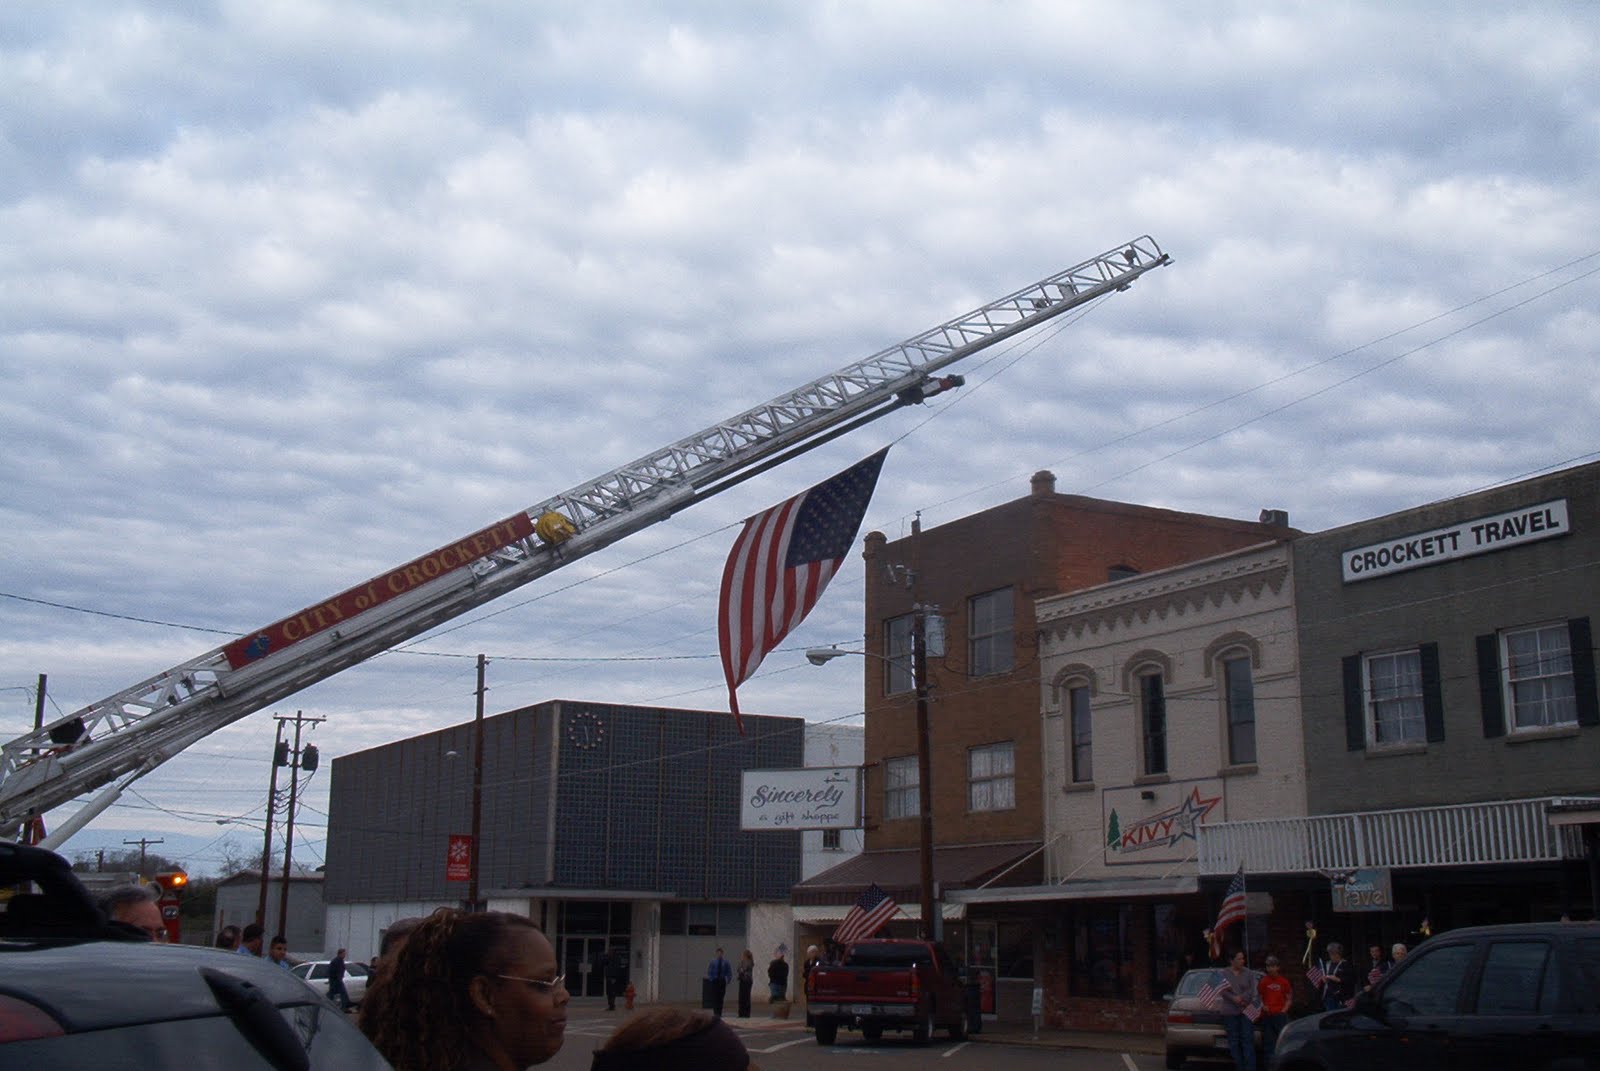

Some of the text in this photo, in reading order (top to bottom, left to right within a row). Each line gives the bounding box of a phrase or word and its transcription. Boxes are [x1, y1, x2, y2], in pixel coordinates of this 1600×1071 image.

[1350, 509, 1559, 573] CROCKETT TRAVEL
[282, 519, 519, 641] CITY of CROCKETT
[750, 784, 844, 811] Sincerely
[774, 811, 795, 825] gift
[801, 810, 840, 824] shoppe
[1122, 818, 1175, 848] KIVY
